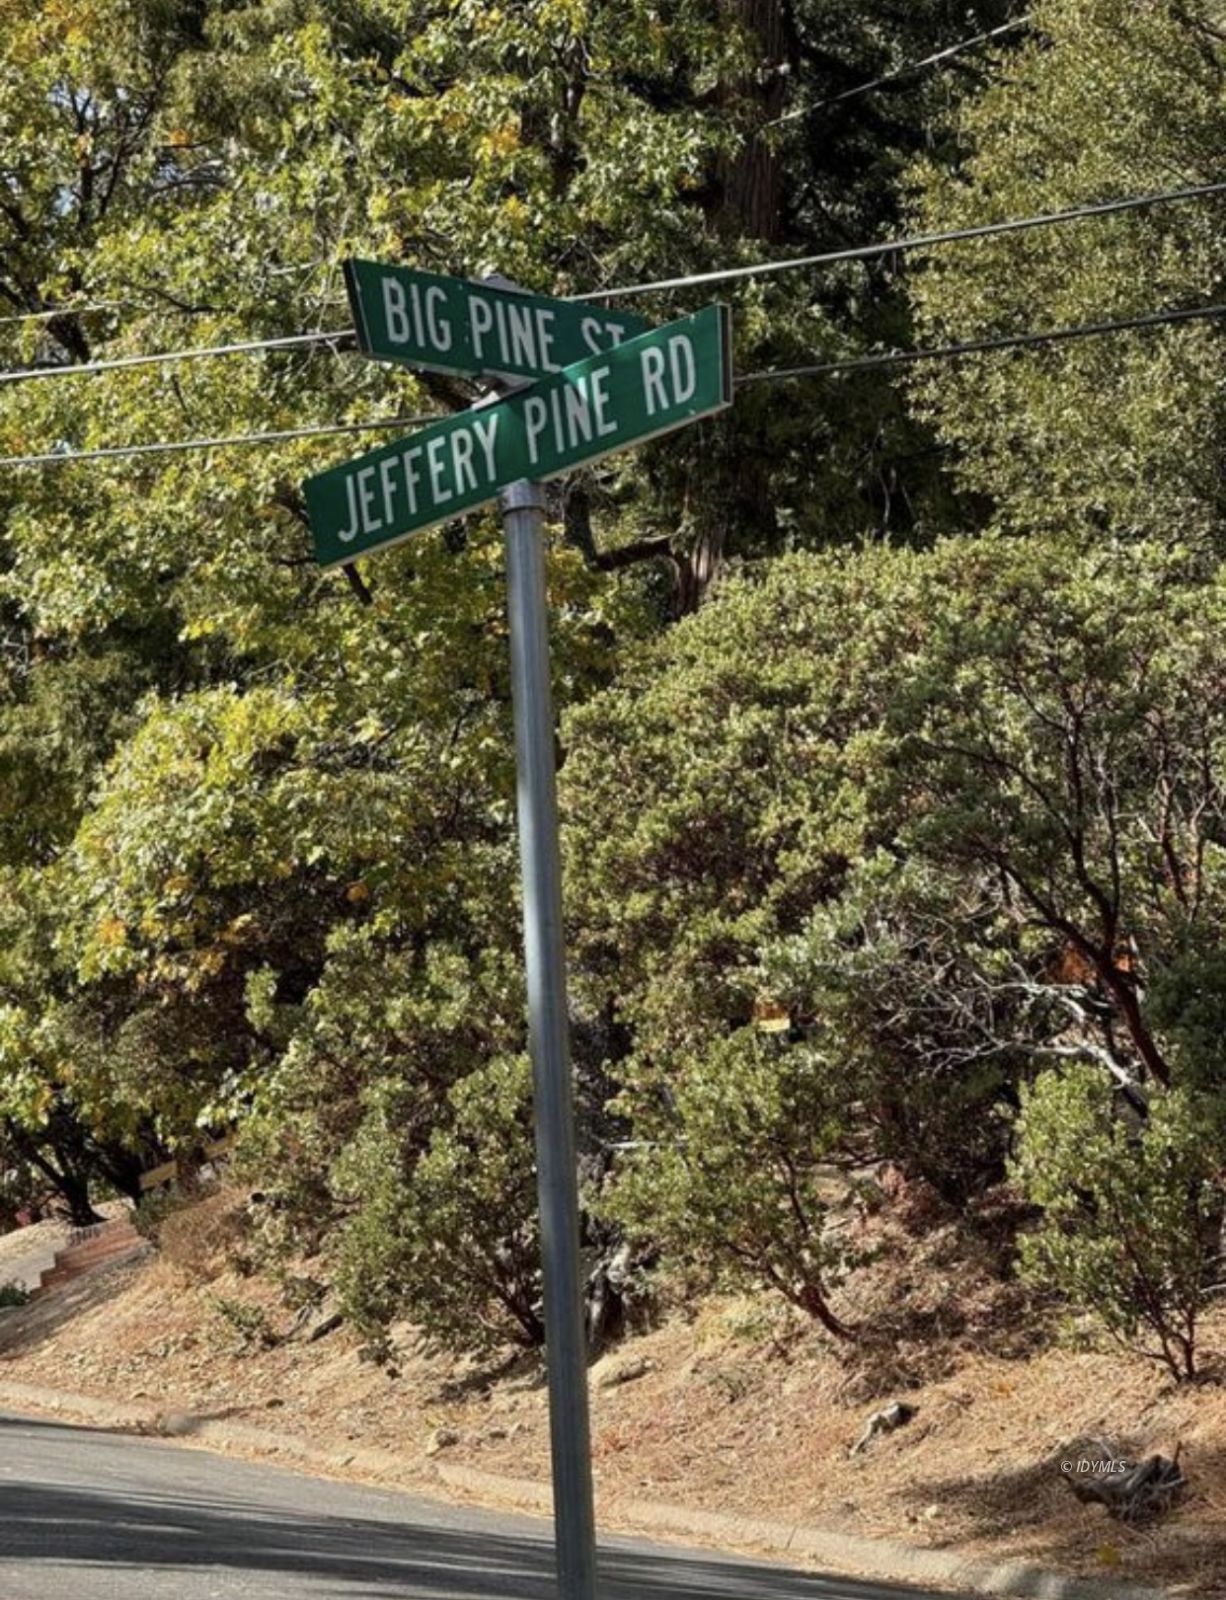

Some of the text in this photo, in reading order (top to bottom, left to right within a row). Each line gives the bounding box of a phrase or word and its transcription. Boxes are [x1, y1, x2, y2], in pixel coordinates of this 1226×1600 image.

[382, 277, 451, 351] BIG
[468, 295, 562, 372] PINE
[338, 334, 696, 543] JEFFERY PINE RD
